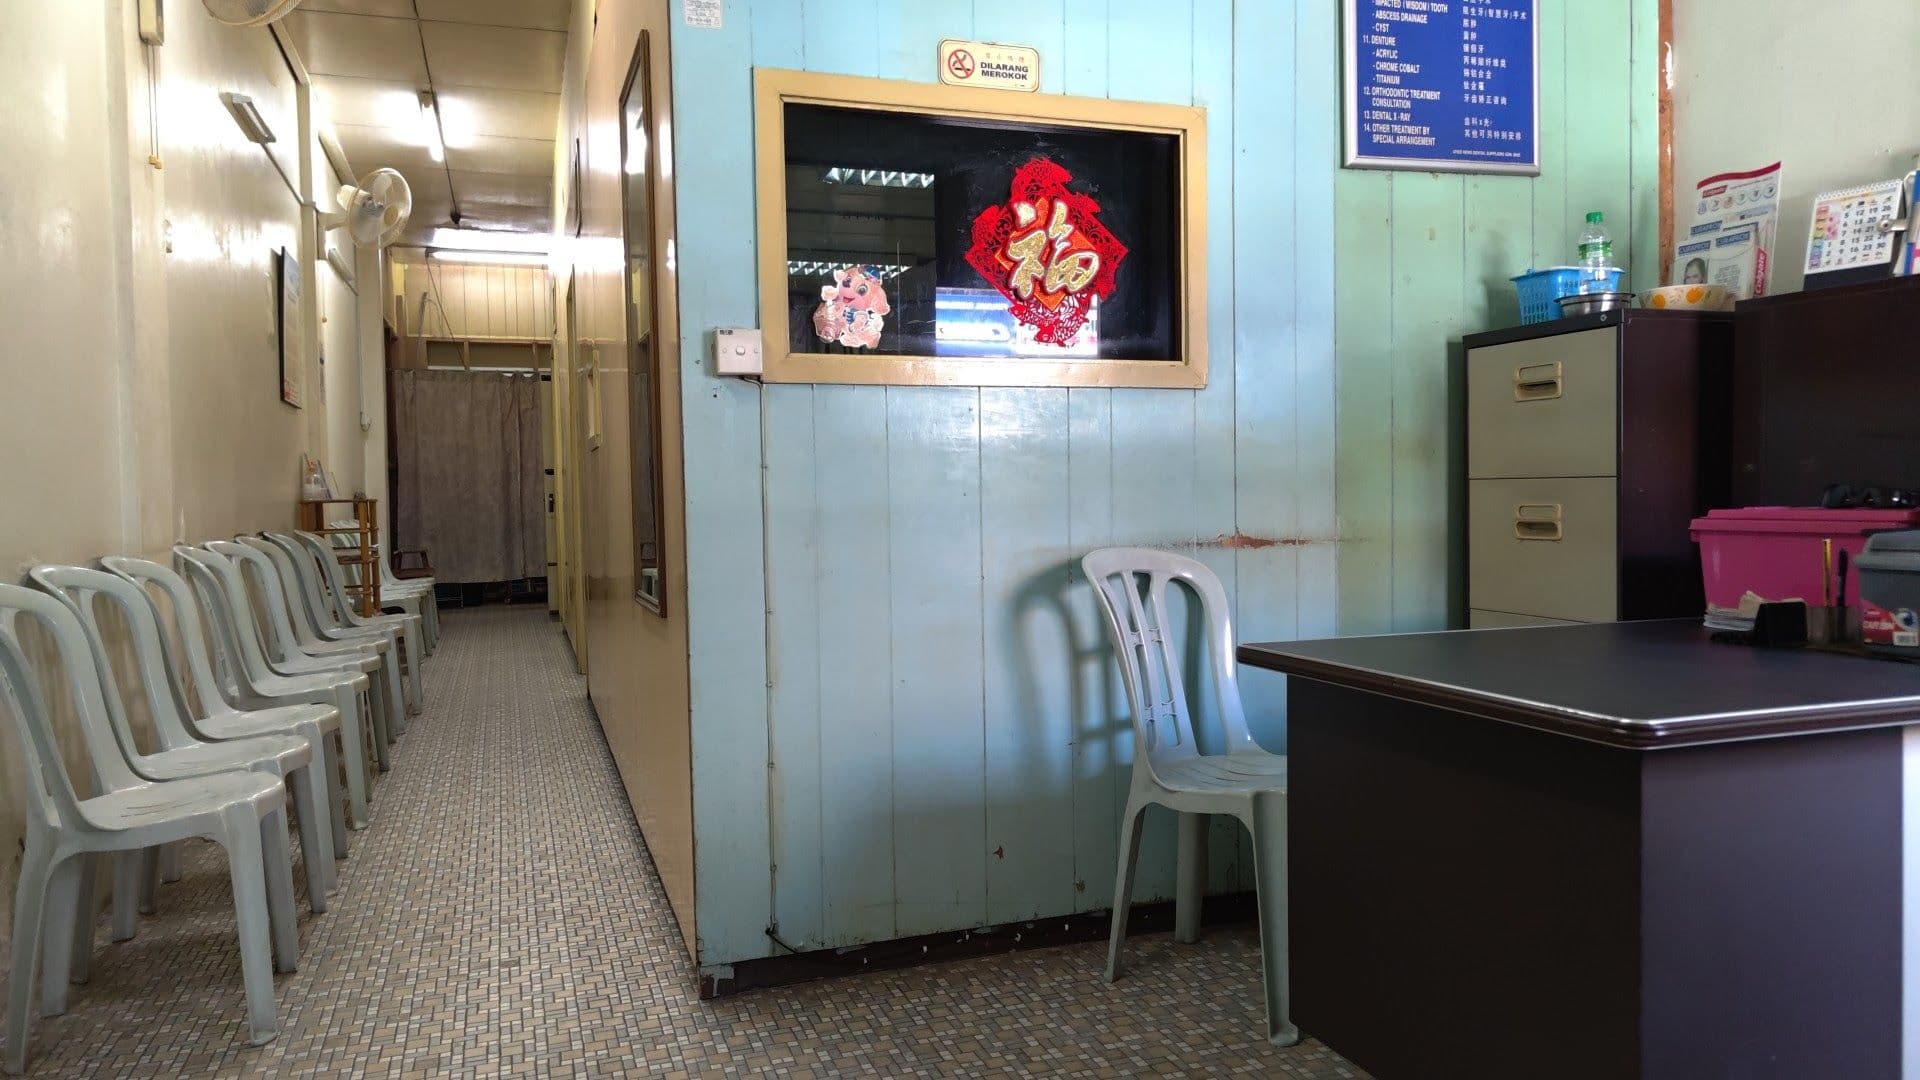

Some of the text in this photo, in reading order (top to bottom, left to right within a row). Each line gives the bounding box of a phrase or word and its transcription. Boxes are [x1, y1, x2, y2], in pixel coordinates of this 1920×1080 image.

[1431, 3, 1448, 13] TOOTH
[1375, 10, 1428, 24] ABSCESS DRAINAGE
[1375, 22, 1390, 32] CYST
[1371, 35, 1396, 46] DENTURE
[1375, 48, 1398, 59] ACRYLIC
[980, 61, 1029, 73] DILARANG
[1375, 61, 1420, 73] CHROME COBALT
[981, 70, 1028, 80] MEROKOK
[1376, 74, 1400, 84] TITANIUM
[1371, 87, 1410, 98] ORTHODONTIC
[1410, 89, 1441, 100] TREATMENT
[1372, 97, 1411, 109] CONSULTATION
[1372, 111, 1392, 121] DENTAL
[1372, 123, 1391, 133] OTHER
[1391, 125, 1422, 135] TREATMENT
[1422, 127, 1430, 135] BY
[1372, 134, 1436, 146] SPECIAL ARRANGEMENT
[1008, 200, 1099, 299] 福
[1755, 251, 1766, 295] Colgate
